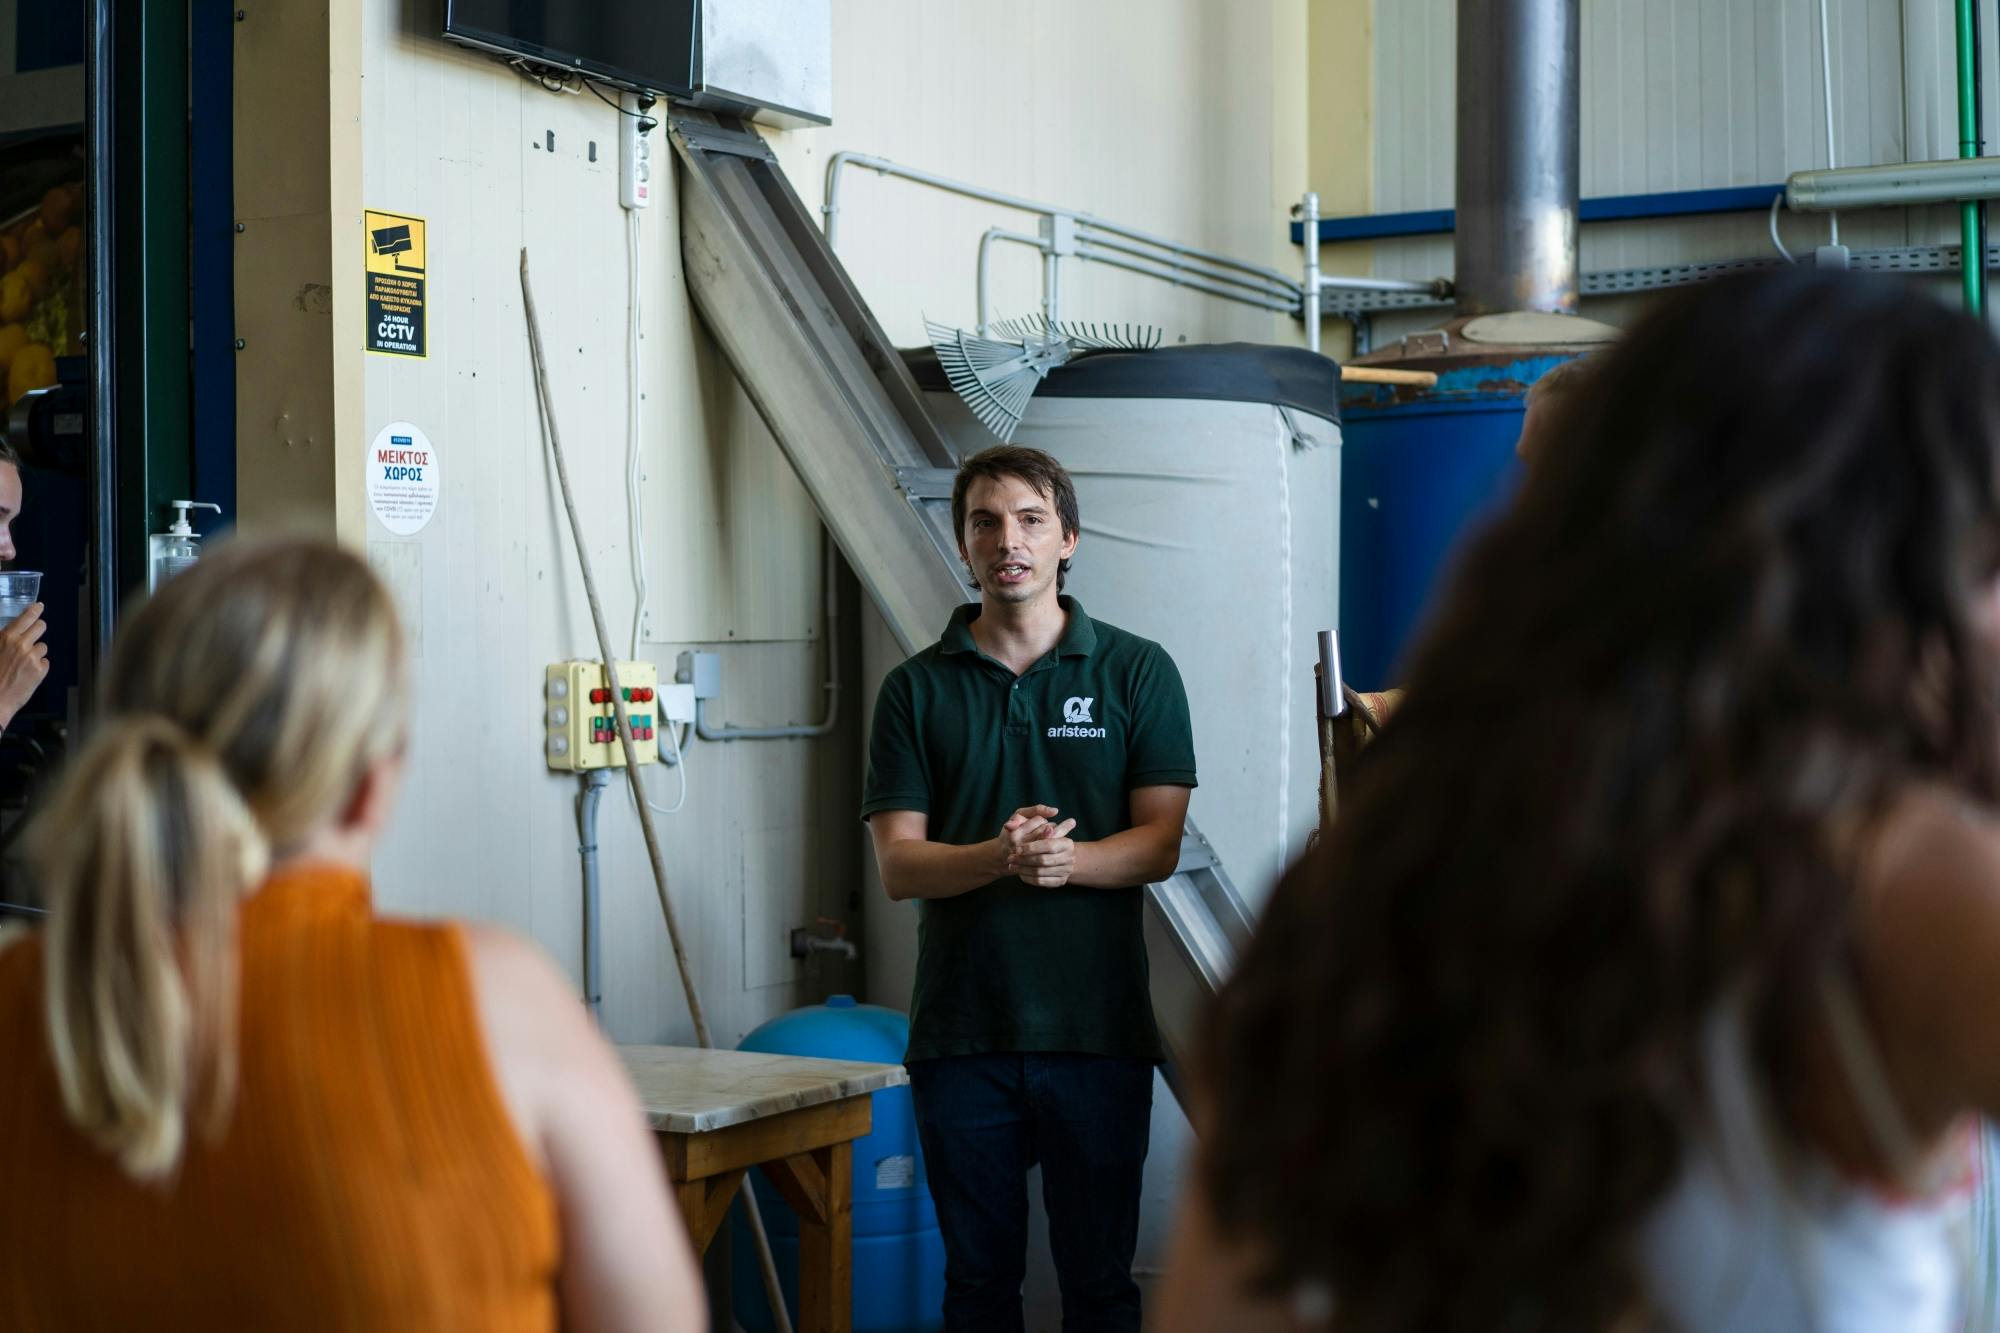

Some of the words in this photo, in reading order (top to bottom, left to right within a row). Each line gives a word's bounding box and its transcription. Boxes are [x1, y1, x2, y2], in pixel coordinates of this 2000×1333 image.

[383, 314, 391, 322] 24
[392, 315, 409, 324] HOUR
[378, 322, 415, 341] CCTV
[376, 340, 383, 348] IN
[384, 341, 416, 352] OPERATION
[378, 449, 429, 466] ΜΕΙΚΤΟΣ
[384, 466, 423, 482] ΧΩΡΟΣ
[1047, 724, 1107, 739] aristeon
